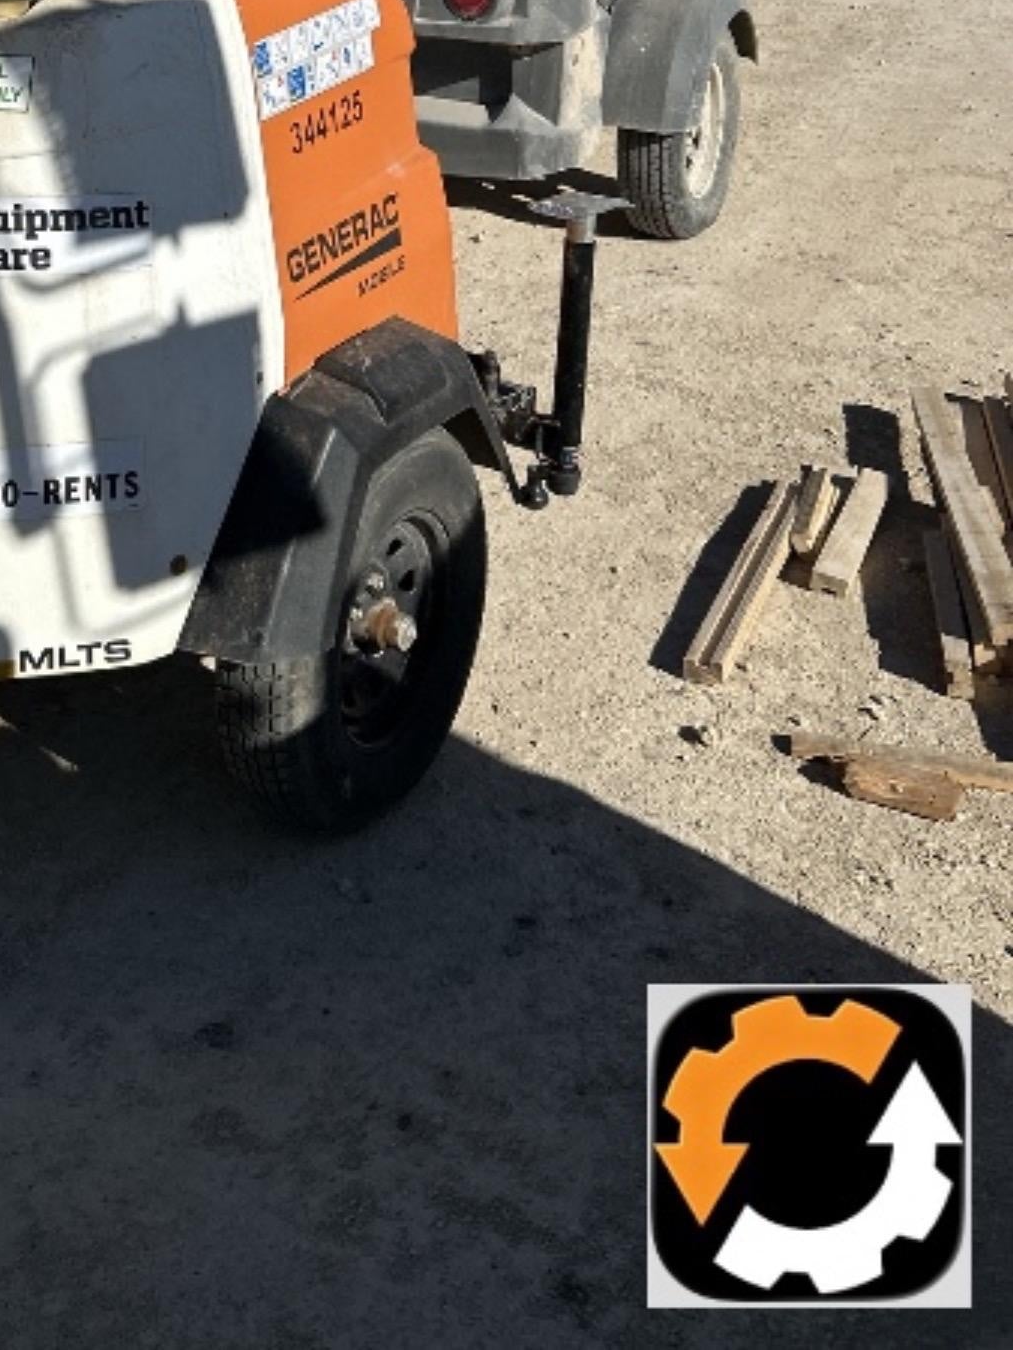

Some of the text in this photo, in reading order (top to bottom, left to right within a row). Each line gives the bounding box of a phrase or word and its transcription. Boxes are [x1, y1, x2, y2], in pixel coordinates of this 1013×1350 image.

[290, 90, 363, 154] 344125
[286, 193, 399, 283] GENERAC
[19, 638, 132, 672] MLTS
